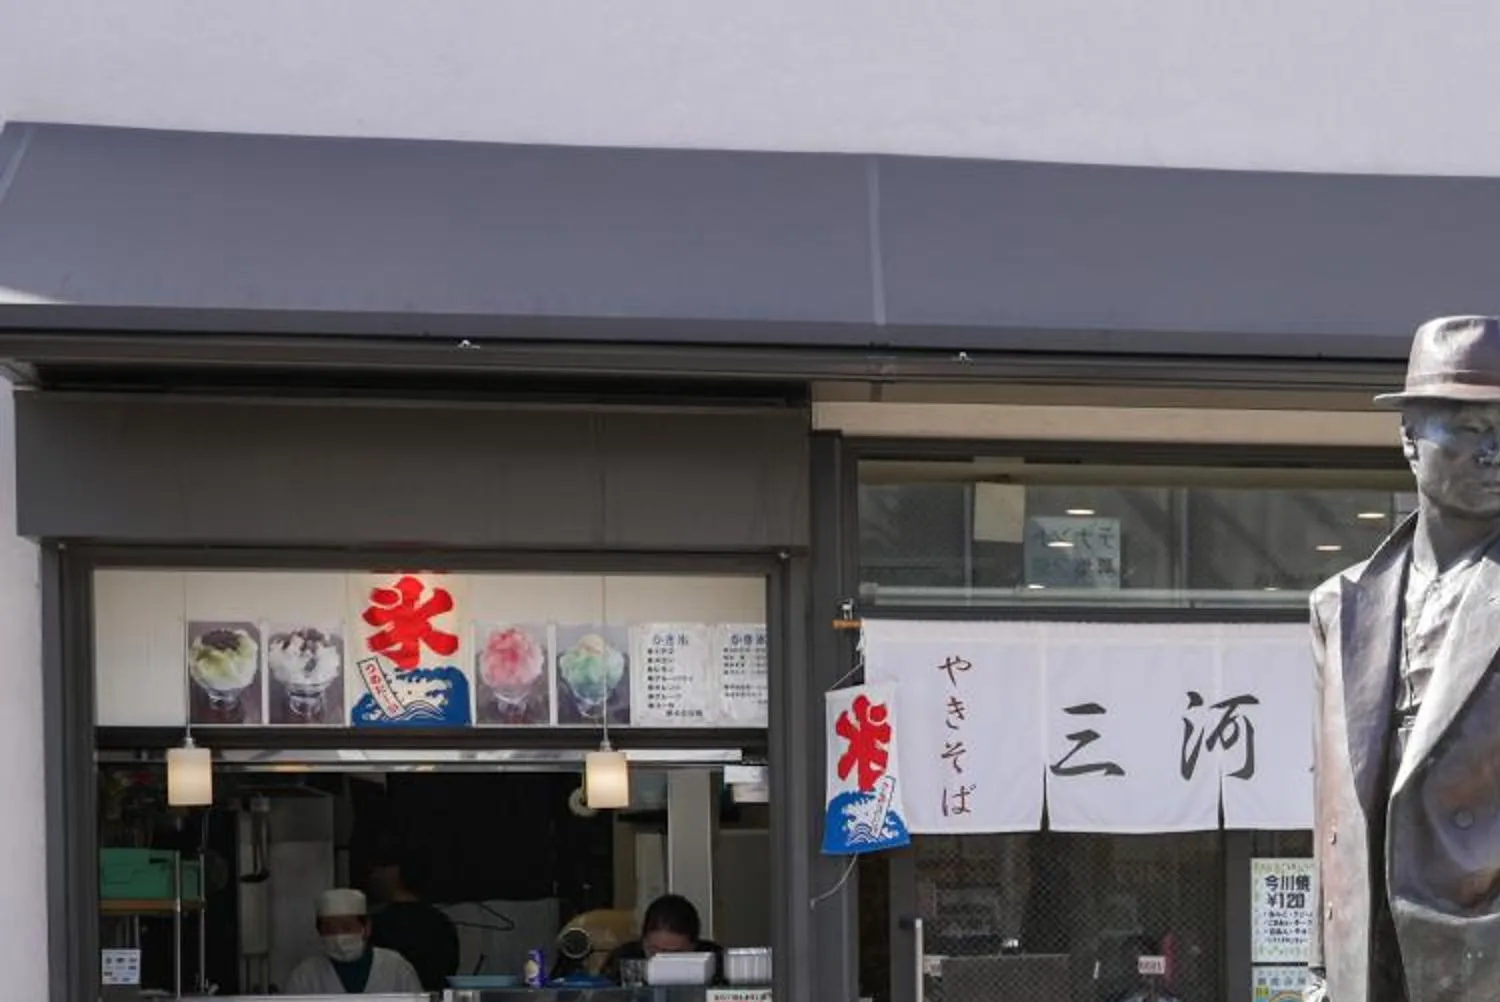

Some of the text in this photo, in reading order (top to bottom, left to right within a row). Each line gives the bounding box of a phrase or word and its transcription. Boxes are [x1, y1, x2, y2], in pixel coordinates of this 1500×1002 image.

[362, 575, 459, 669] 氷
[938, 655, 977, 817] やきそば
[1049, 690, 1261, 781] 三河
[1264, 874, 1311, 892] 今川焼
[1266, 892, 1305, 909] ¥120
